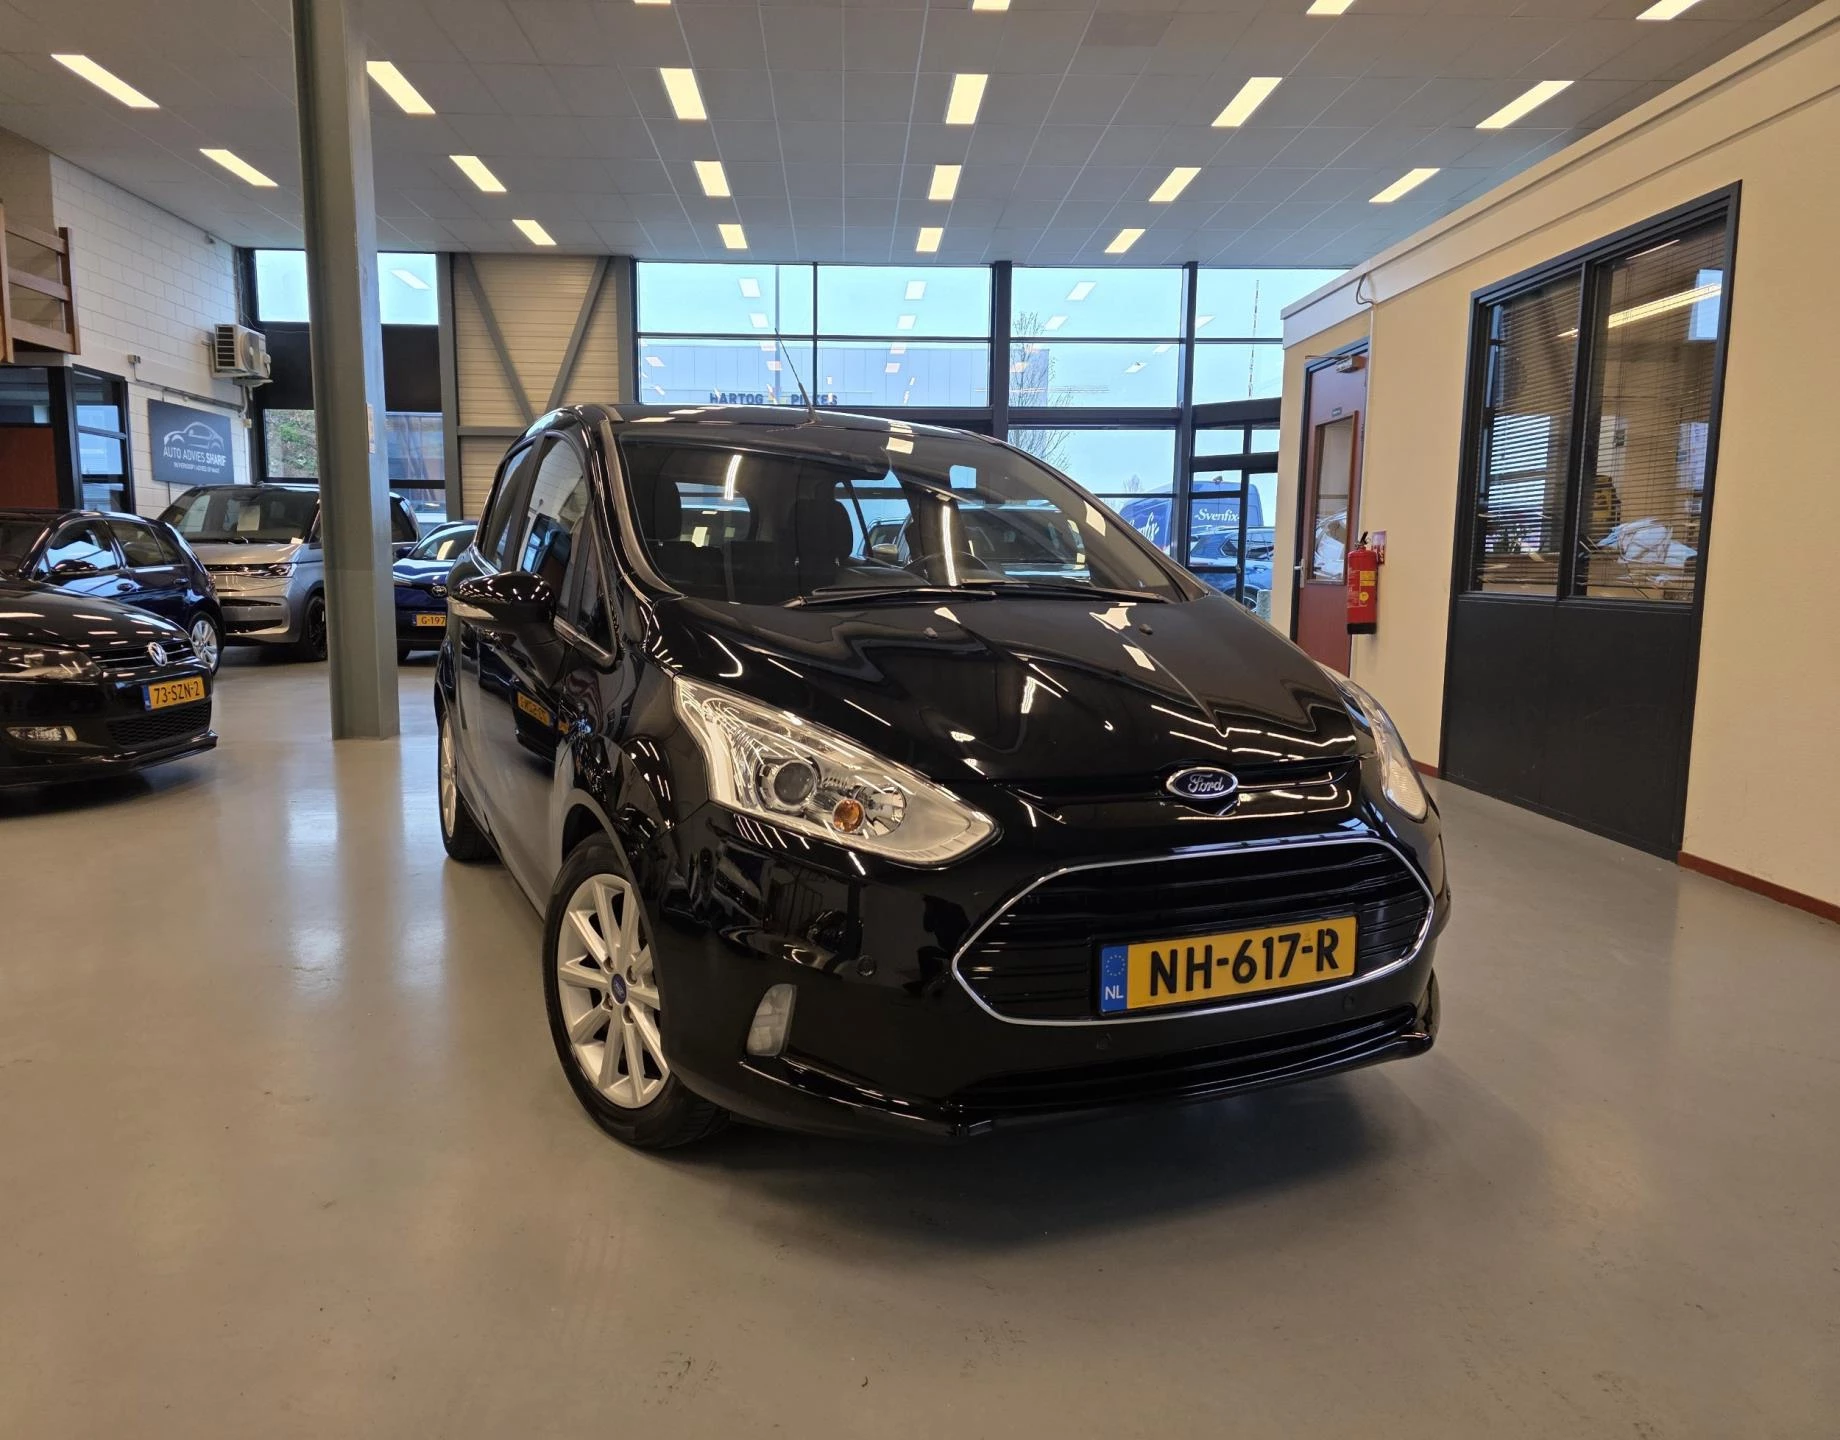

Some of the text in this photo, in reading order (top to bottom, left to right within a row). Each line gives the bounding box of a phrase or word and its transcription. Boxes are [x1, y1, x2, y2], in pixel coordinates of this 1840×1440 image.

[709, 392, 764, 405] HARTOG
[163, 446, 182, 460] AUTO
[182, 449, 206, 463] ADVIES
[153, 680, 201, 705] 73-SZN-2
[1187, 773, 1225, 793] Ford
[1149, 927, 1340, 998] NH-617-R
[1104, 984, 1125, 1001] NL
